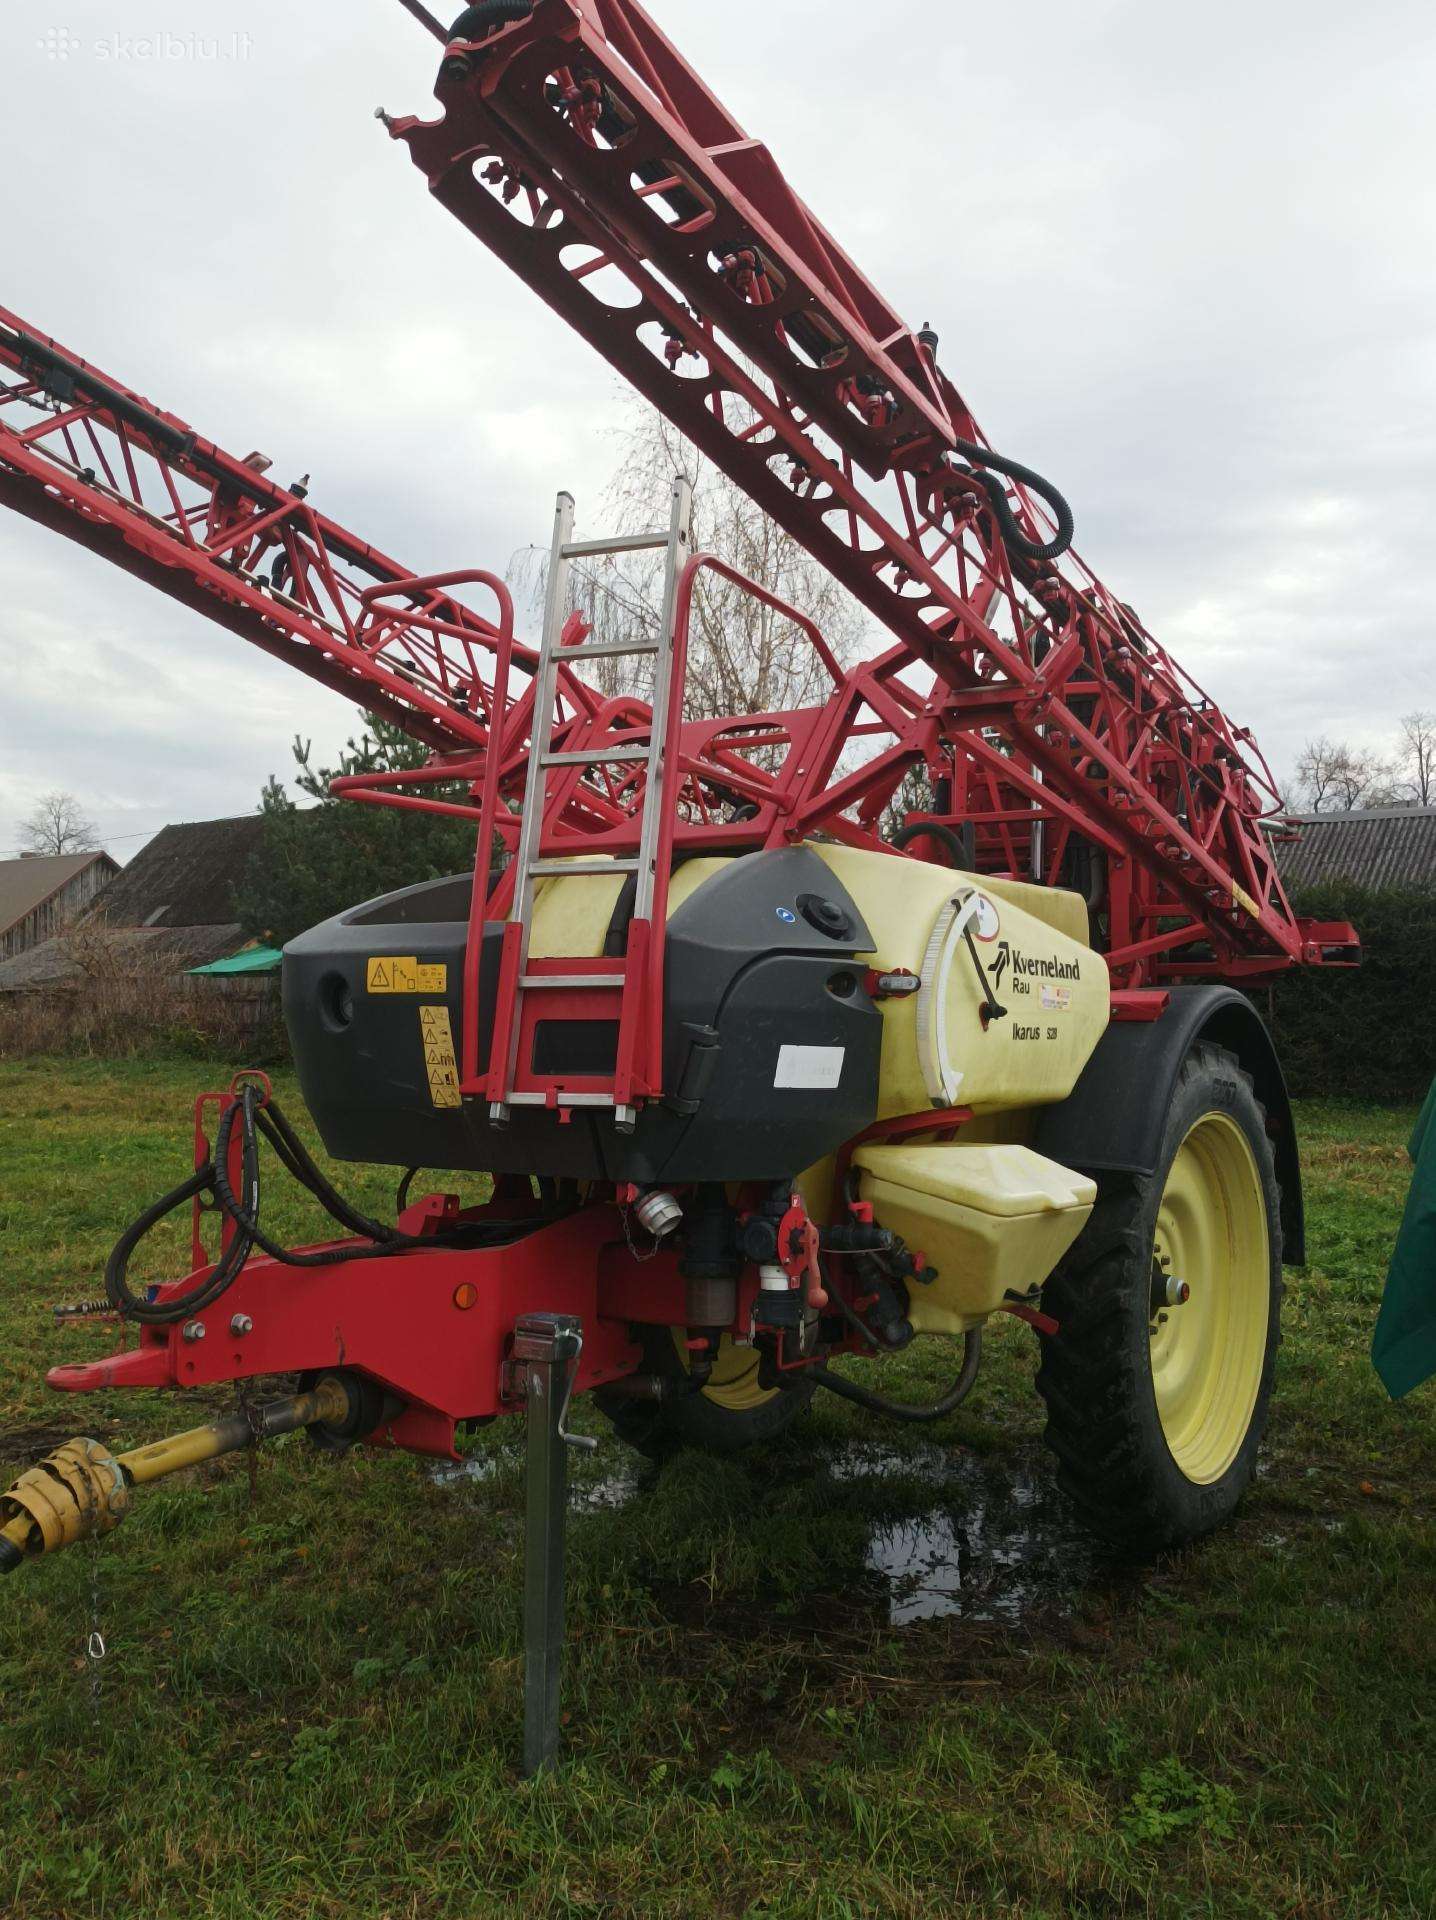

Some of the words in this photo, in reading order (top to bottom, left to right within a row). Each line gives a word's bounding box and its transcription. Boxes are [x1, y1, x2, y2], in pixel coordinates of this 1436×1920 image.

[1012, 950, 1080, 980] Kverneland
[1013, 978, 1029, 994] Rau
[1012, 1023, 1040, 1040] Ikarus
